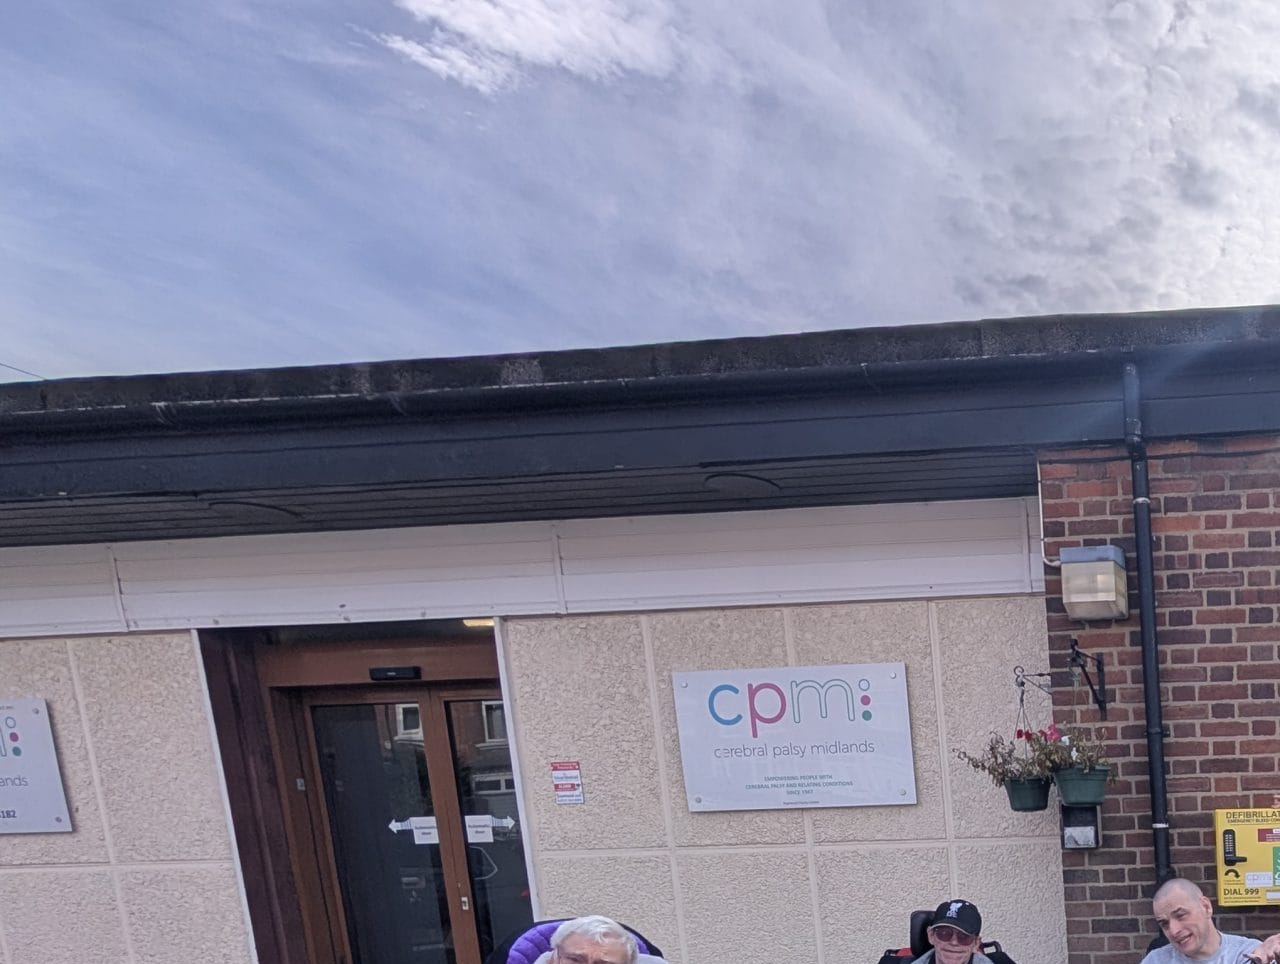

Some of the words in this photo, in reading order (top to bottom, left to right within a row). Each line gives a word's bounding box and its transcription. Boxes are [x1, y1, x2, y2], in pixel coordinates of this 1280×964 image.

[714, 743, 767, 759] cerebral
[773, 742, 806, 758] palsy
[811, 740, 875, 755] midlands
[0, 809, 17, 819] 182
